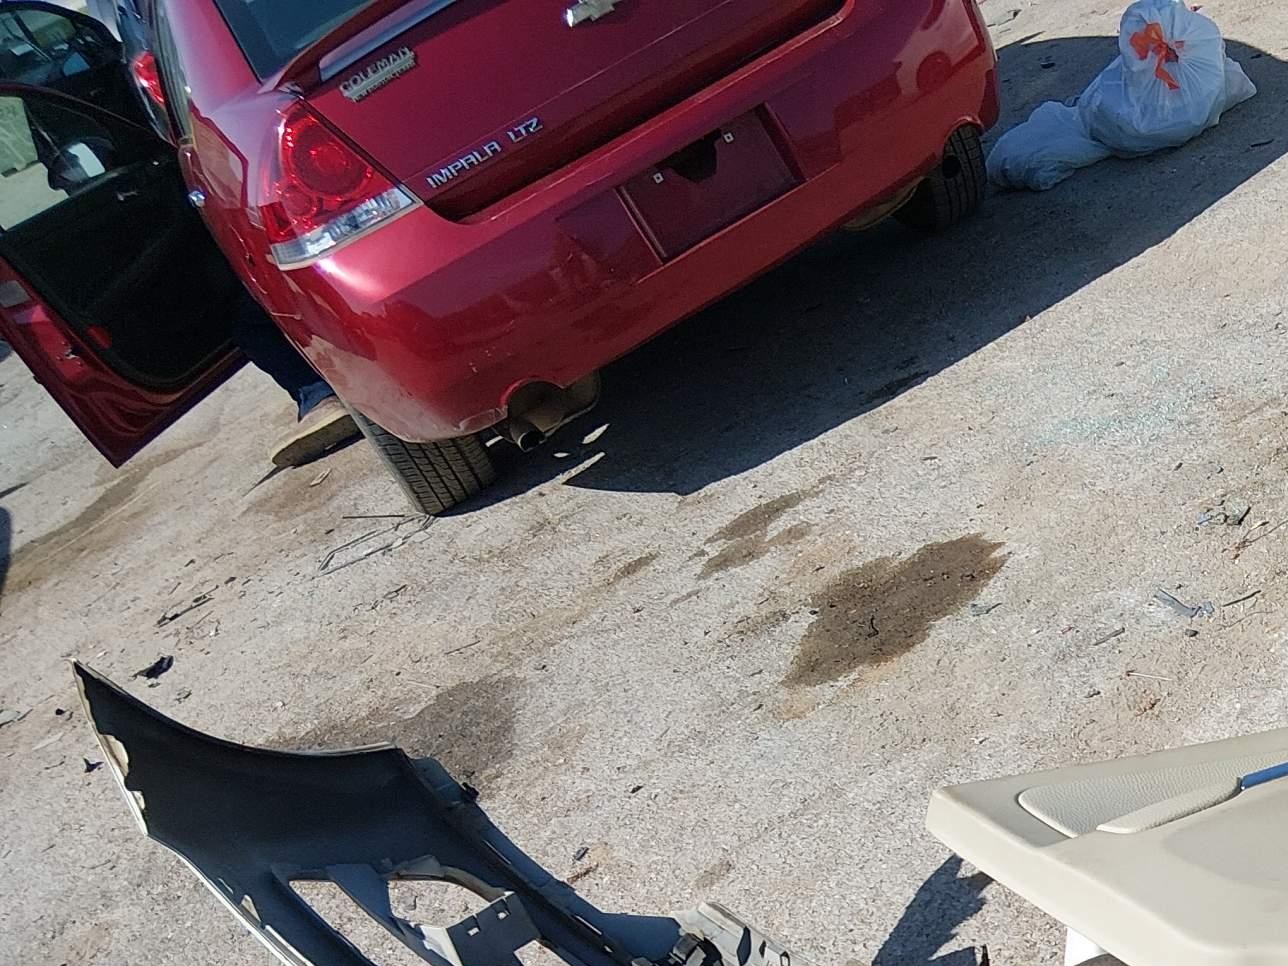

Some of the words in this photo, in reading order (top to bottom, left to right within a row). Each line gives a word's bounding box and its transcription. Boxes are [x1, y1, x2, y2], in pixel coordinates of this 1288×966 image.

[339, 47, 412, 94] COLEMAN
[426, 141, 502, 189] IMPALA
[506, 117, 544, 143] LTZ
